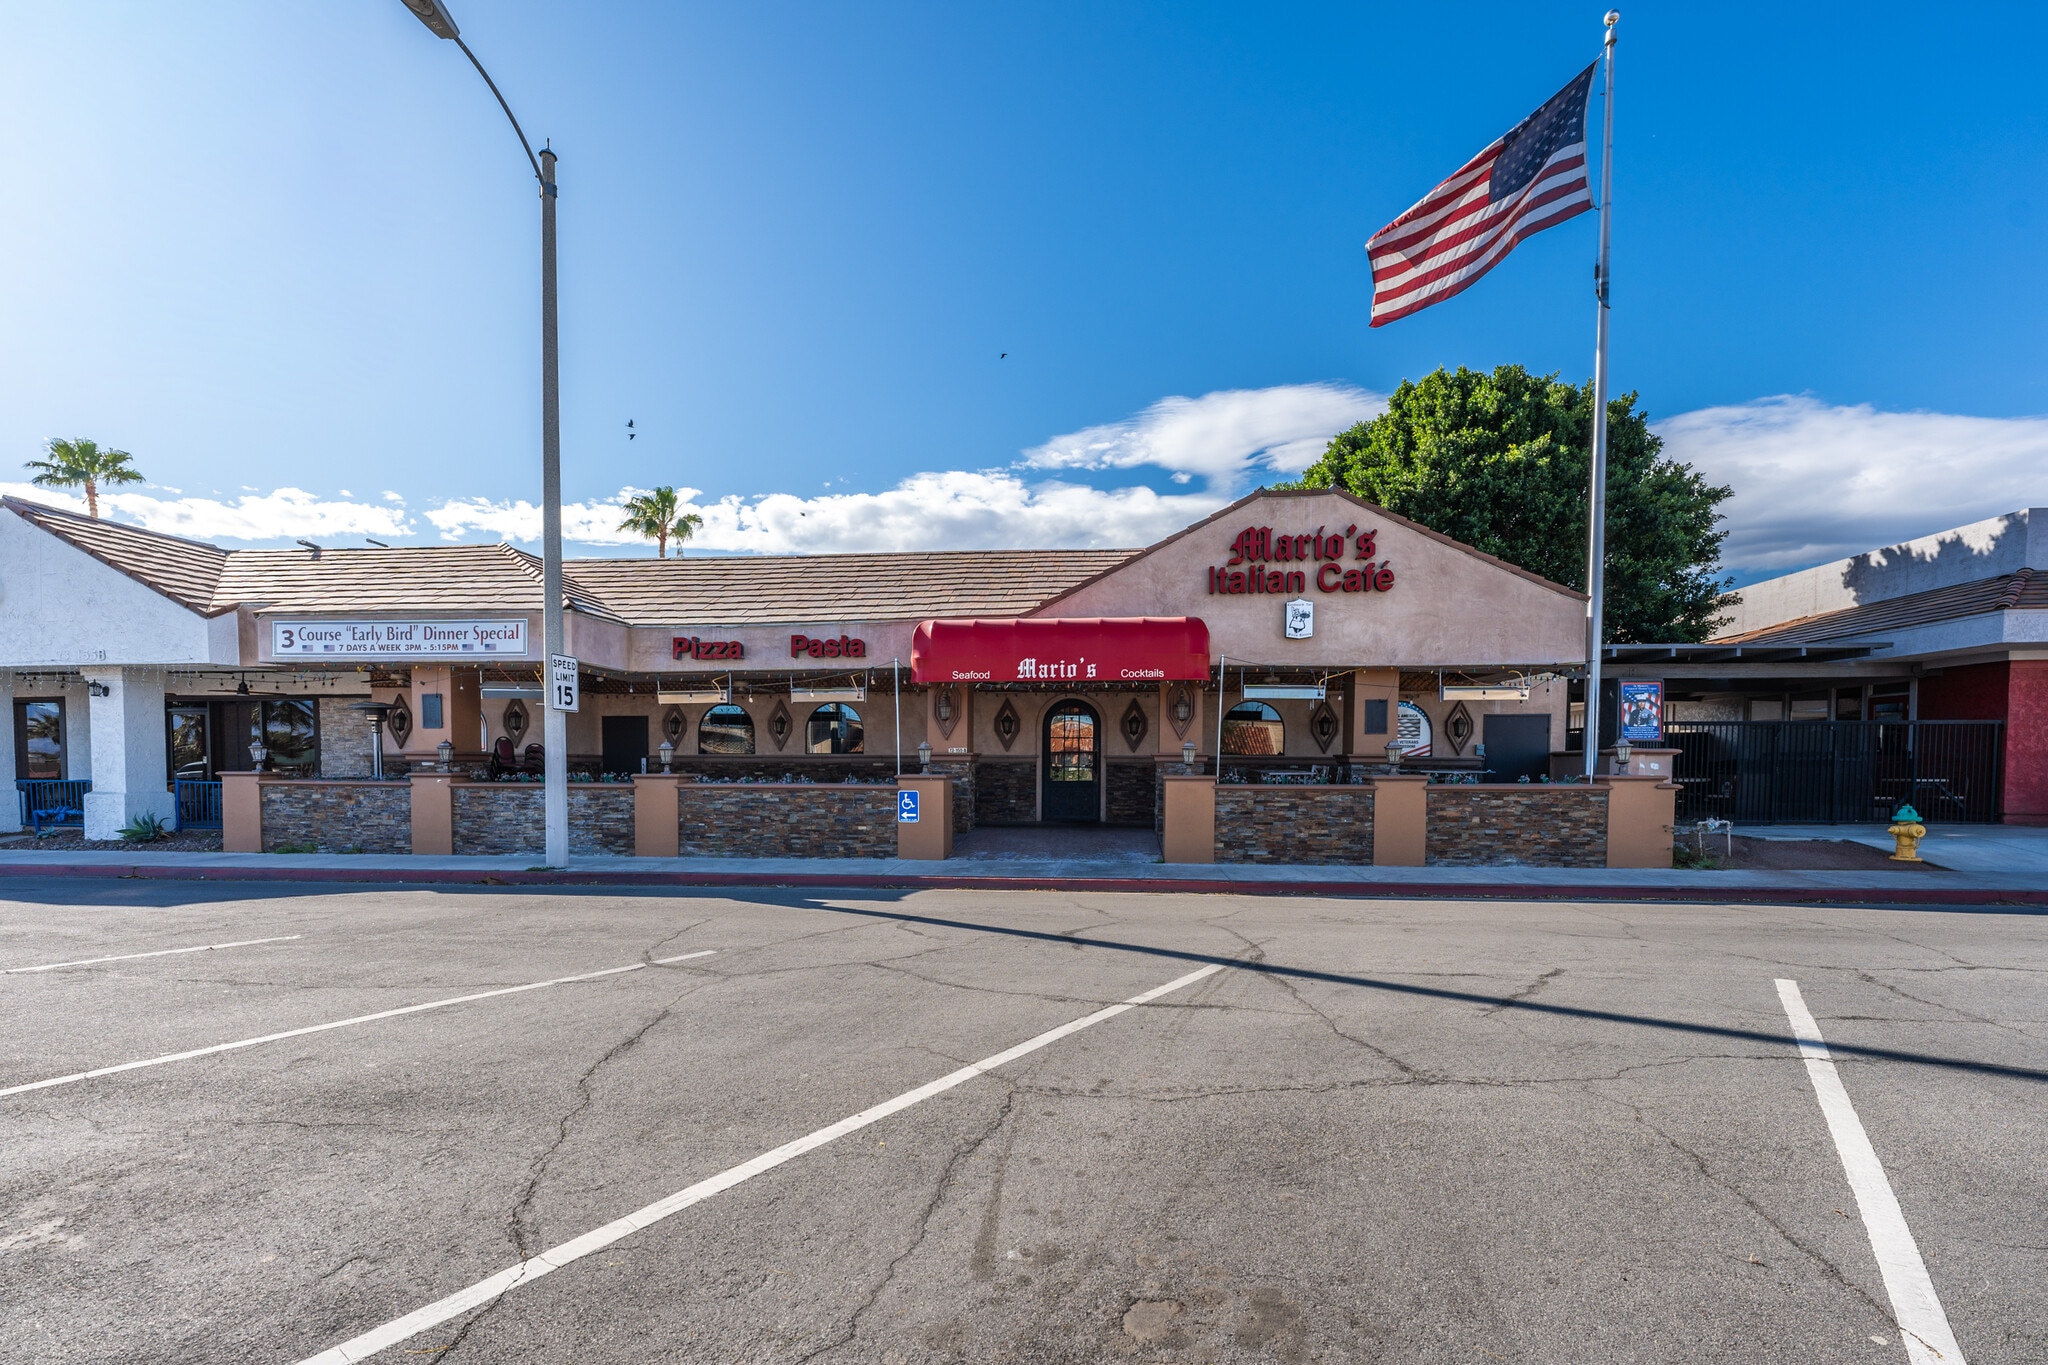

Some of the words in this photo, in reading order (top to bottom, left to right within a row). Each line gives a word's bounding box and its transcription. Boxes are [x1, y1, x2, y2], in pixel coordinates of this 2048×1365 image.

[1228, 524, 1377, 566] Mario's
[1208, 565, 1305, 594] Italian
[1317, 560, 1395, 593] Café
[281, 629, 295, 648] 3
[298, 626, 342, 641] Course
[423, 625, 469, 640] Dinner
[473, 624, 519, 645] Special
[790, 634, 866, 658] Pasta
[346, 644, 367, 652] DAYS
[369, 644, 376, 652] A
[378, 644, 401, 652] WEEK
[404, 644, 422, 652] 3PM
[673, 636, 744, 660] Pizza
[553, 659, 577, 671] SPEED
[952, 670, 990, 680] Seafood
[1120, 669, 1165, 679] Cocktails
[1016, 657, 1097, 679] Mario's
[556, 672, 575, 682] LIMIT
[557, 685, 574, 706] 15
